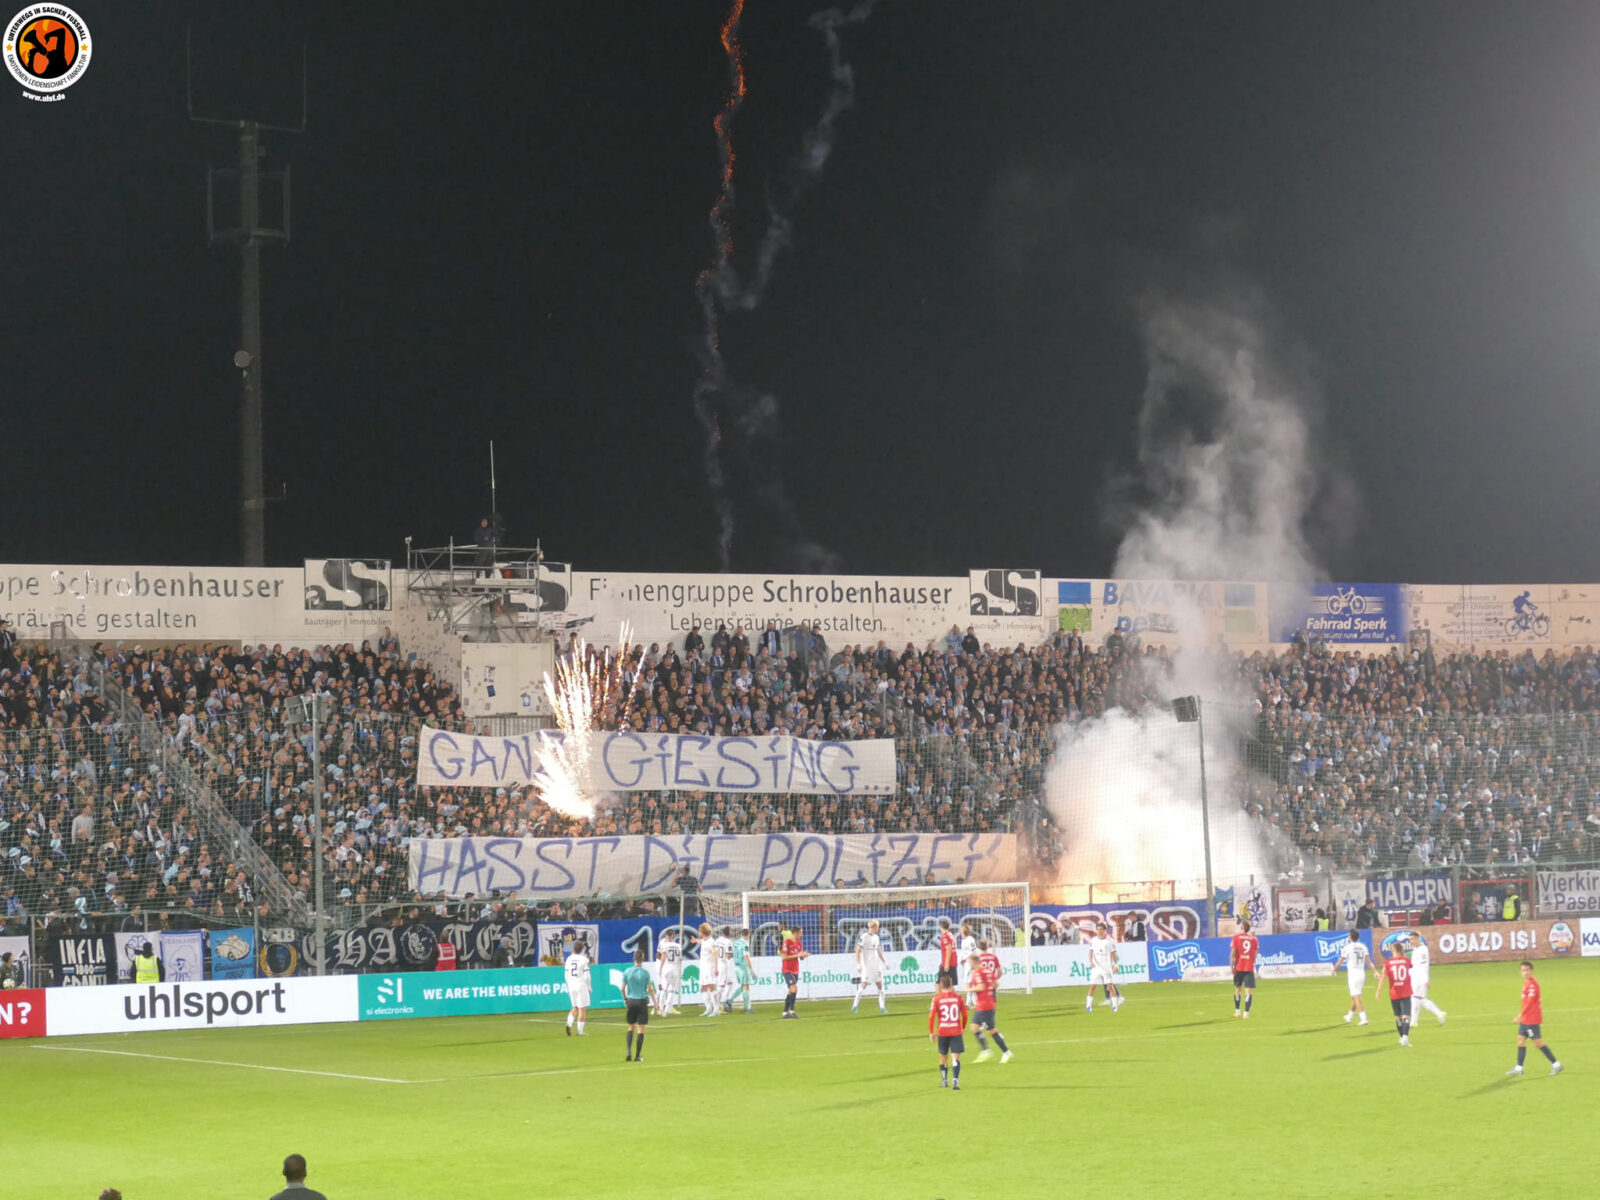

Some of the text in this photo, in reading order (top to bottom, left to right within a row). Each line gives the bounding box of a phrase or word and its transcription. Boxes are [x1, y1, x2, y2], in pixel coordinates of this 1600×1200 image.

[50, 569, 284, 599] Schrobenhauser
[763, 579, 953, 605] Schrobenhauser
[96, 607, 198, 633] gestalten
[670, 611, 795, 632] Lebensräume
[1306, 616, 1388, 632] Fahrrad Sperk
[417, 836, 617, 892] HASST
[1369, 879, 1452, 910] HADERN
[59, 938, 106, 965] INFLA
[1242, 939, 1251, 954] 9
[1438, 930, 1537, 954] OBAZD IS!
[1156, 946, 1198, 967] Bayern
[570, 960, 578, 977] 2
[1390, 964, 1407, 981] 10
[423, 983, 568, 1000] WE ARE THE MISSING PA
[124, 982, 286, 1024] uhlsport
[376, 1005, 414, 1015] electronics
[939, 1003, 959, 1022] 30
